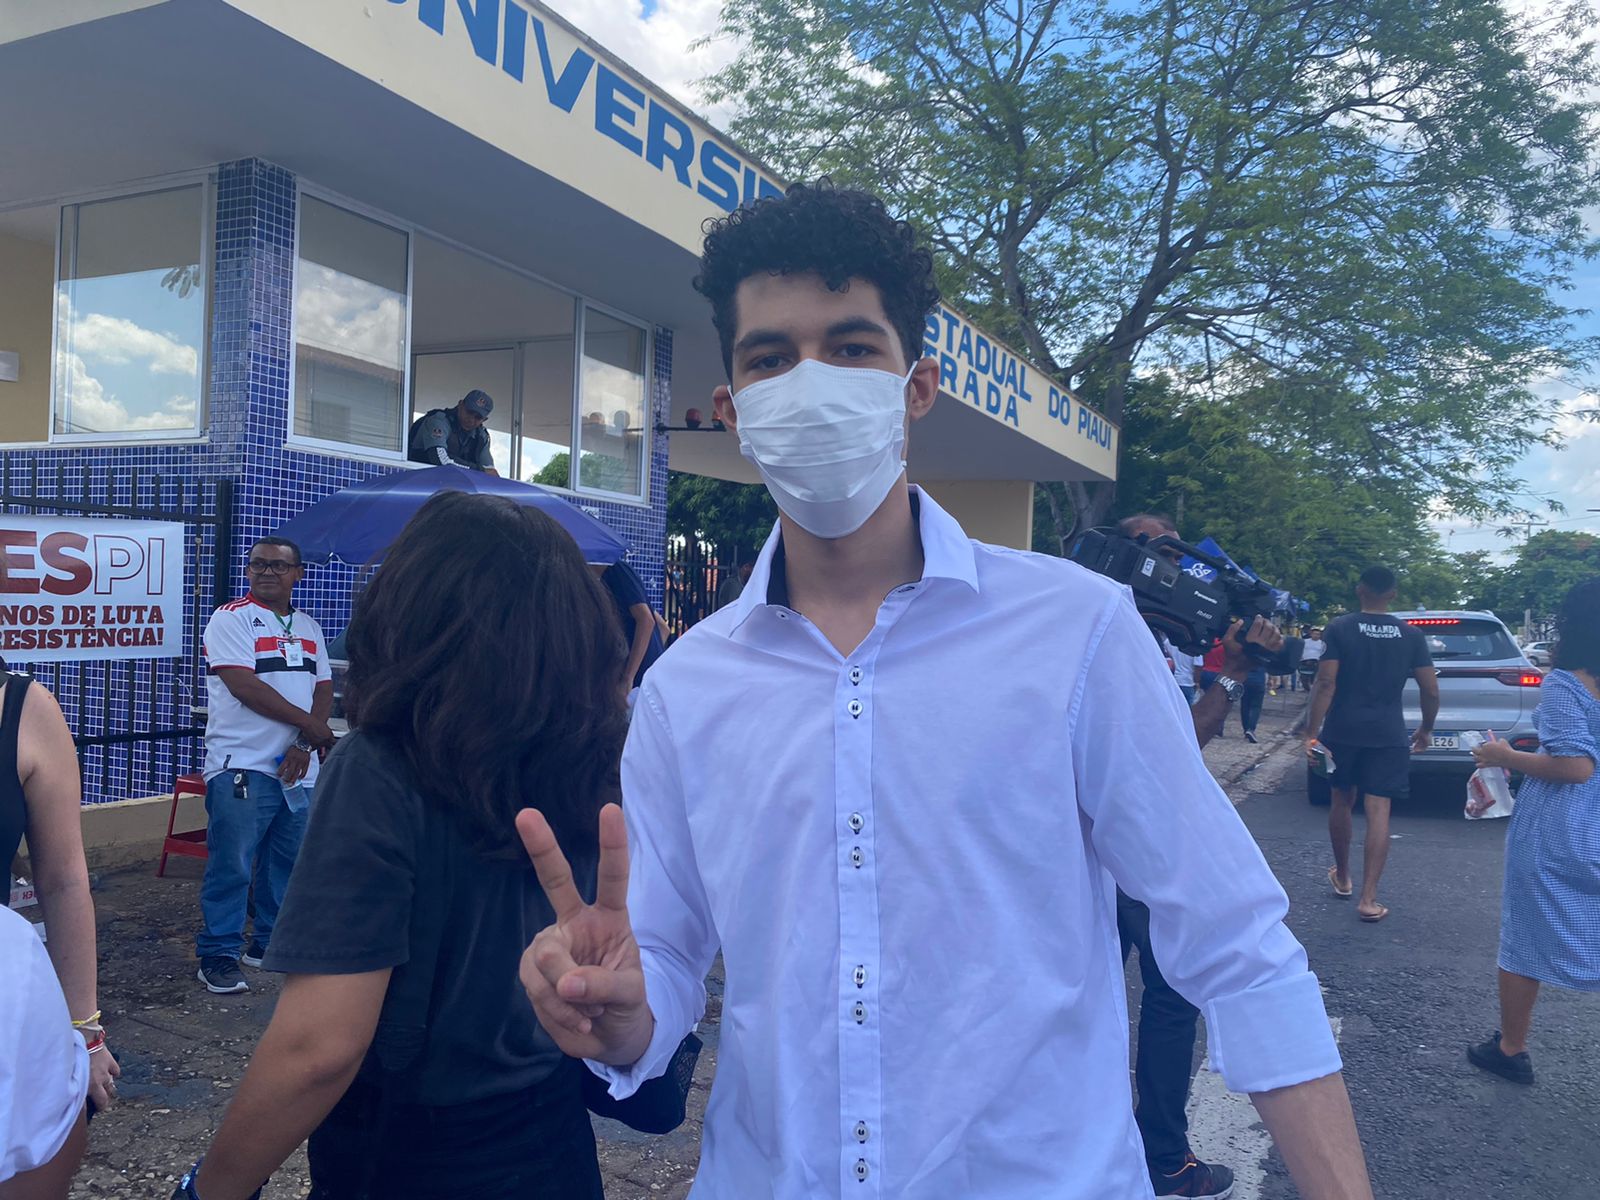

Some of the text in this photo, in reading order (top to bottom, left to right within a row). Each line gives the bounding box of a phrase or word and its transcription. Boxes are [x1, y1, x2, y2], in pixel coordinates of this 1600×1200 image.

[386, 0, 1112, 450] NIVERSI STADUAL DO PIAUI
[61, 605, 96, 625] DE
[101, 605, 164, 624] LUTA
[0, 624, 164, 650] ESISTÊNCIA!
[1358, 622, 1402, 638] WAKANDA
